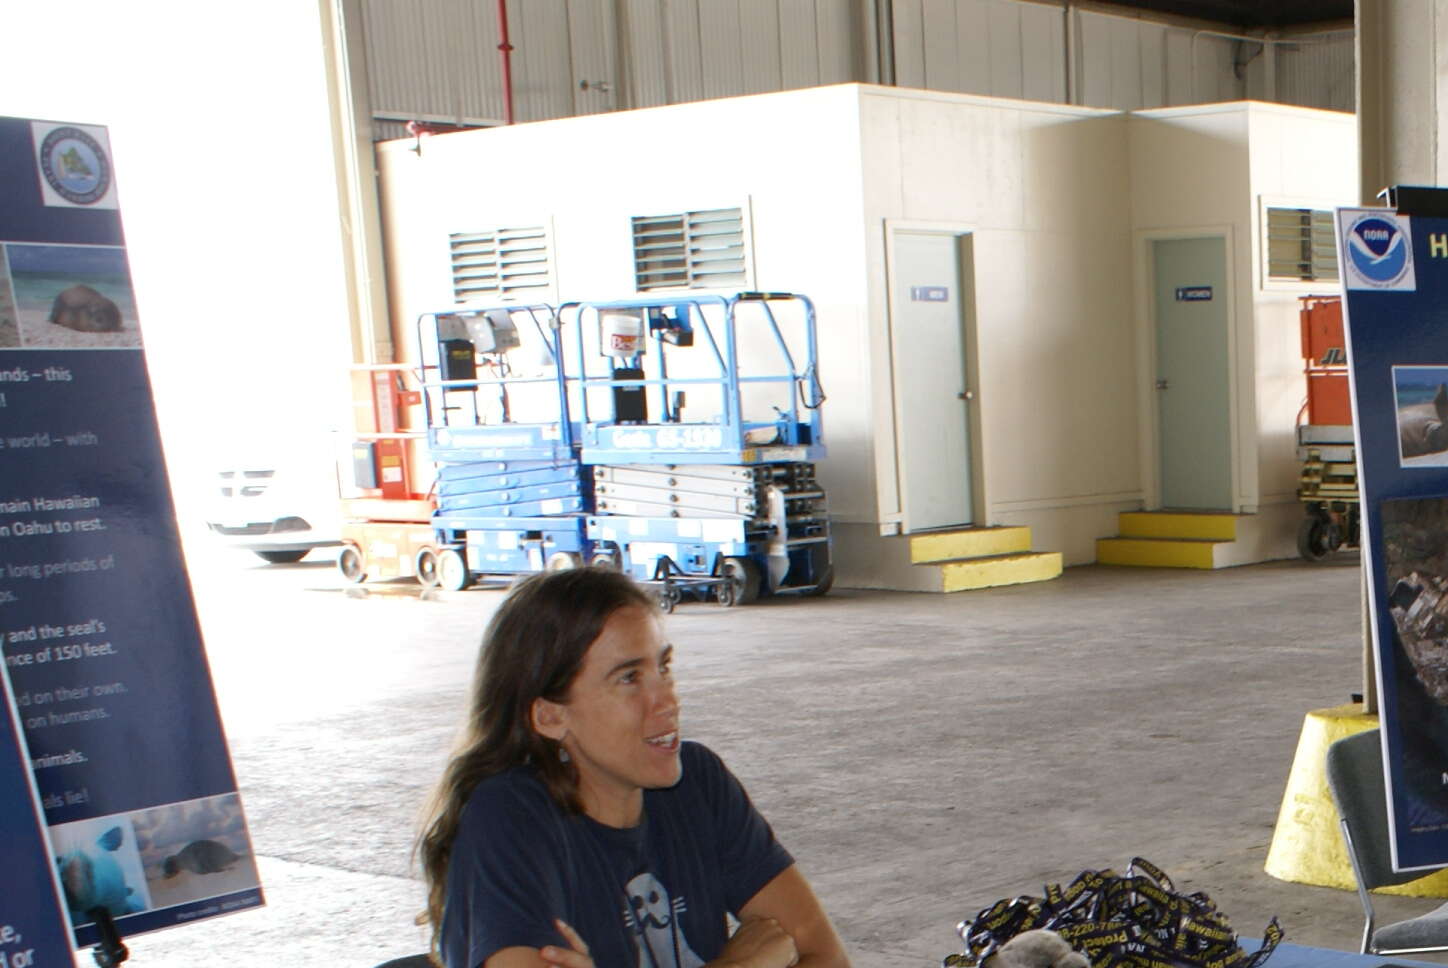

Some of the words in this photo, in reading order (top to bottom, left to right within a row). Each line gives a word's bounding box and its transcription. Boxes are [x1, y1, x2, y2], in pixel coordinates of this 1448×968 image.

[44, 366, 72, 382] this
[8, 432, 51, 448] world
[65, 431, 98, 446] with
[33, 494, 100, 511] Hawaiian
[12, 520, 53, 536] Oahu
[55, 520, 73, 533] to
[74, 518, 107, 532] rest.
[8, 563, 42, 579] long
[44, 557, 98, 578] periods
[99, 554, 114, 570] of
[8, 626, 37, 643] and
[38, 623, 64, 639] the
[36, 649, 51, 664] of
[55, 644, 82, 661] 150
[83, 641, 118, 657] feet.
[34, 691, 53, 706] on
[56, 685, 90, 702] their
[27, 714, 47, 729] on
[49, 707, 112, 725] humans.
[32, 750, 89, 770] nimals.
[12, 948, 34, 968] or
